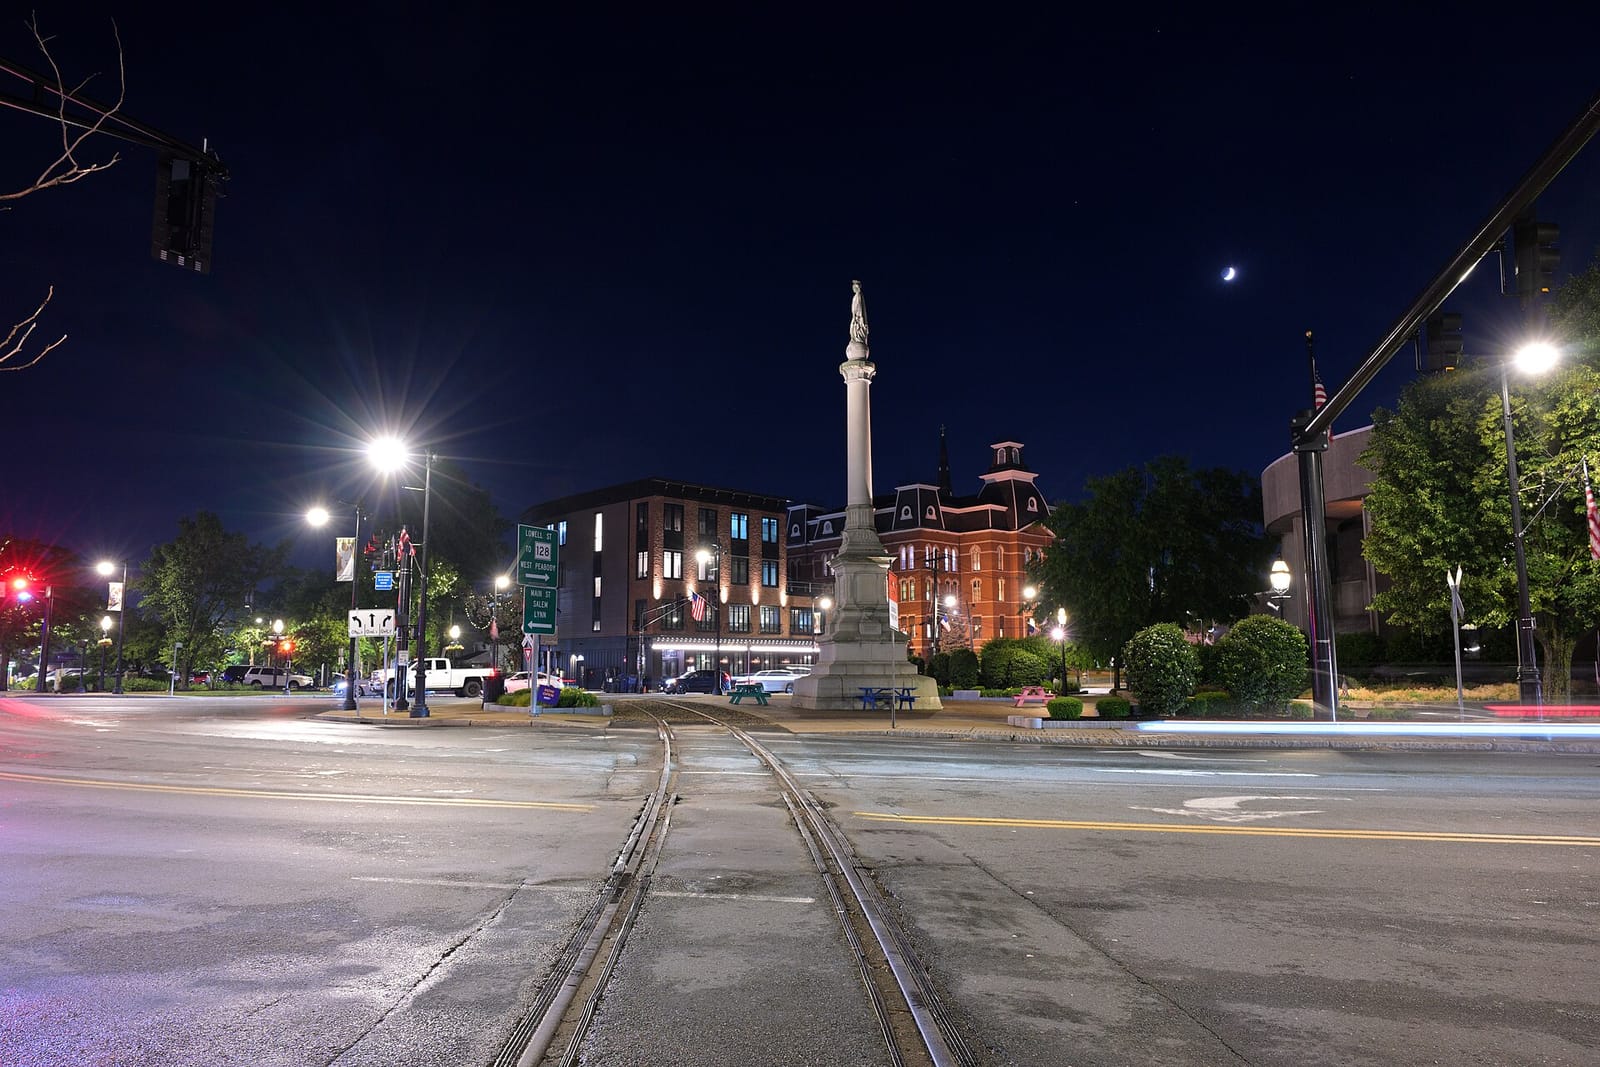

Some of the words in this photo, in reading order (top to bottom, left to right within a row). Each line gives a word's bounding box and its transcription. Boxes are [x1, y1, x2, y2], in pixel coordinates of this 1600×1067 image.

[525, 529, 543, 539] LOWELL
[525, 545, 532, 553] TO
[536, 545, 549, 557] 128
[520, 560, 532, 569] WEST
[535, 562, 556, 572] PEABODY
[530, 589, 542, 597] MAIN
[545, 591, 551, 599] ST
[533, 600, 548, 608] SALEM
[534, 610, 547, 618] LYNN
